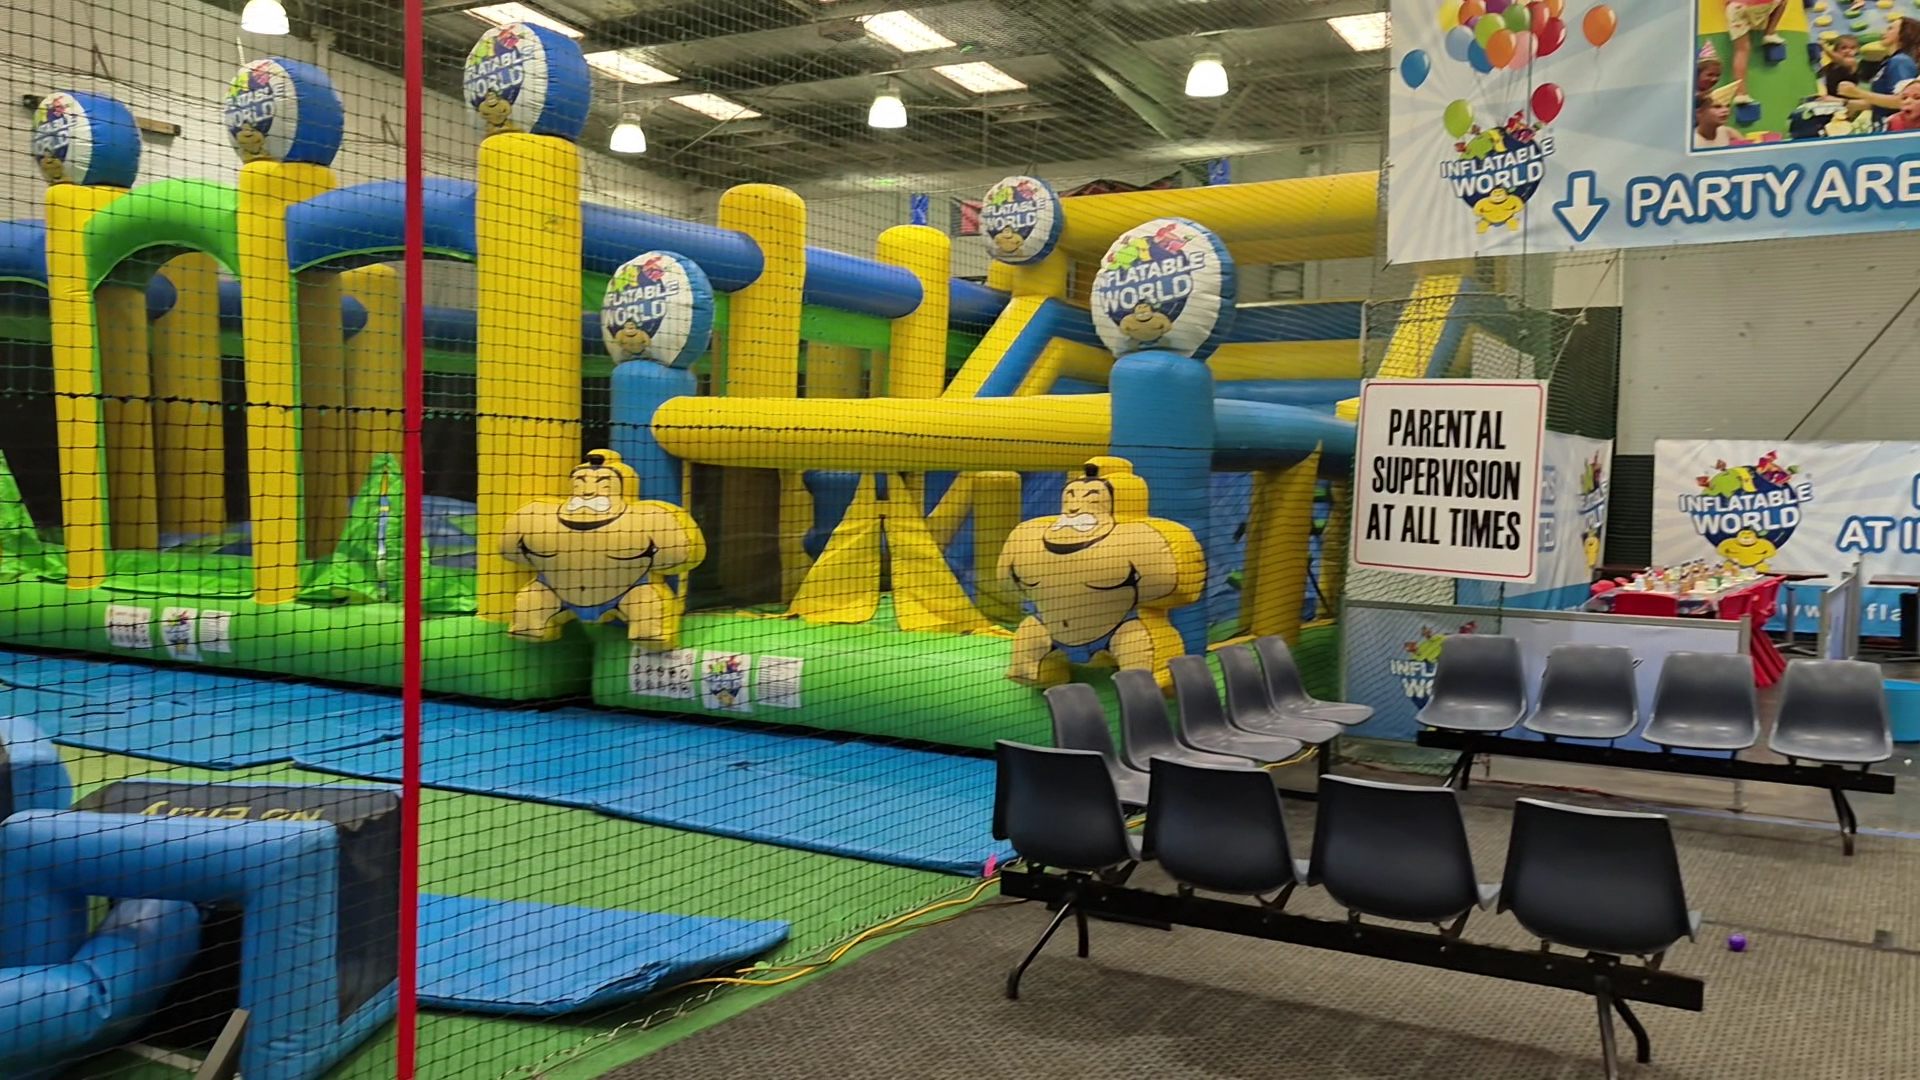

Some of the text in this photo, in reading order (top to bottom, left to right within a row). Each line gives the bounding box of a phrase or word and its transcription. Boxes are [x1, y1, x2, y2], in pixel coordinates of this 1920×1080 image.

[1440, 136, 1556, 179] INFLATABLE
[1453, 161, 1545, 199] WORLD
[1629, 167, 1802, 224] PARTY
[1099, 274, 1193, 314] WORLD
[1388, 408, 1507, 450] PARENTAL
[1372, 455, 1521, 501] SUPERVISION
[1679, 482, 1814, 513] INFLATABLE
[1366, 503, 1395, 541] AT
[1401, 505, 1440, 545] ALL
[1449, 507, 1522, 551] TIMES
[1693, 506, 1800, 535] WORLD
[1838, 517, 1895, 552] AT
